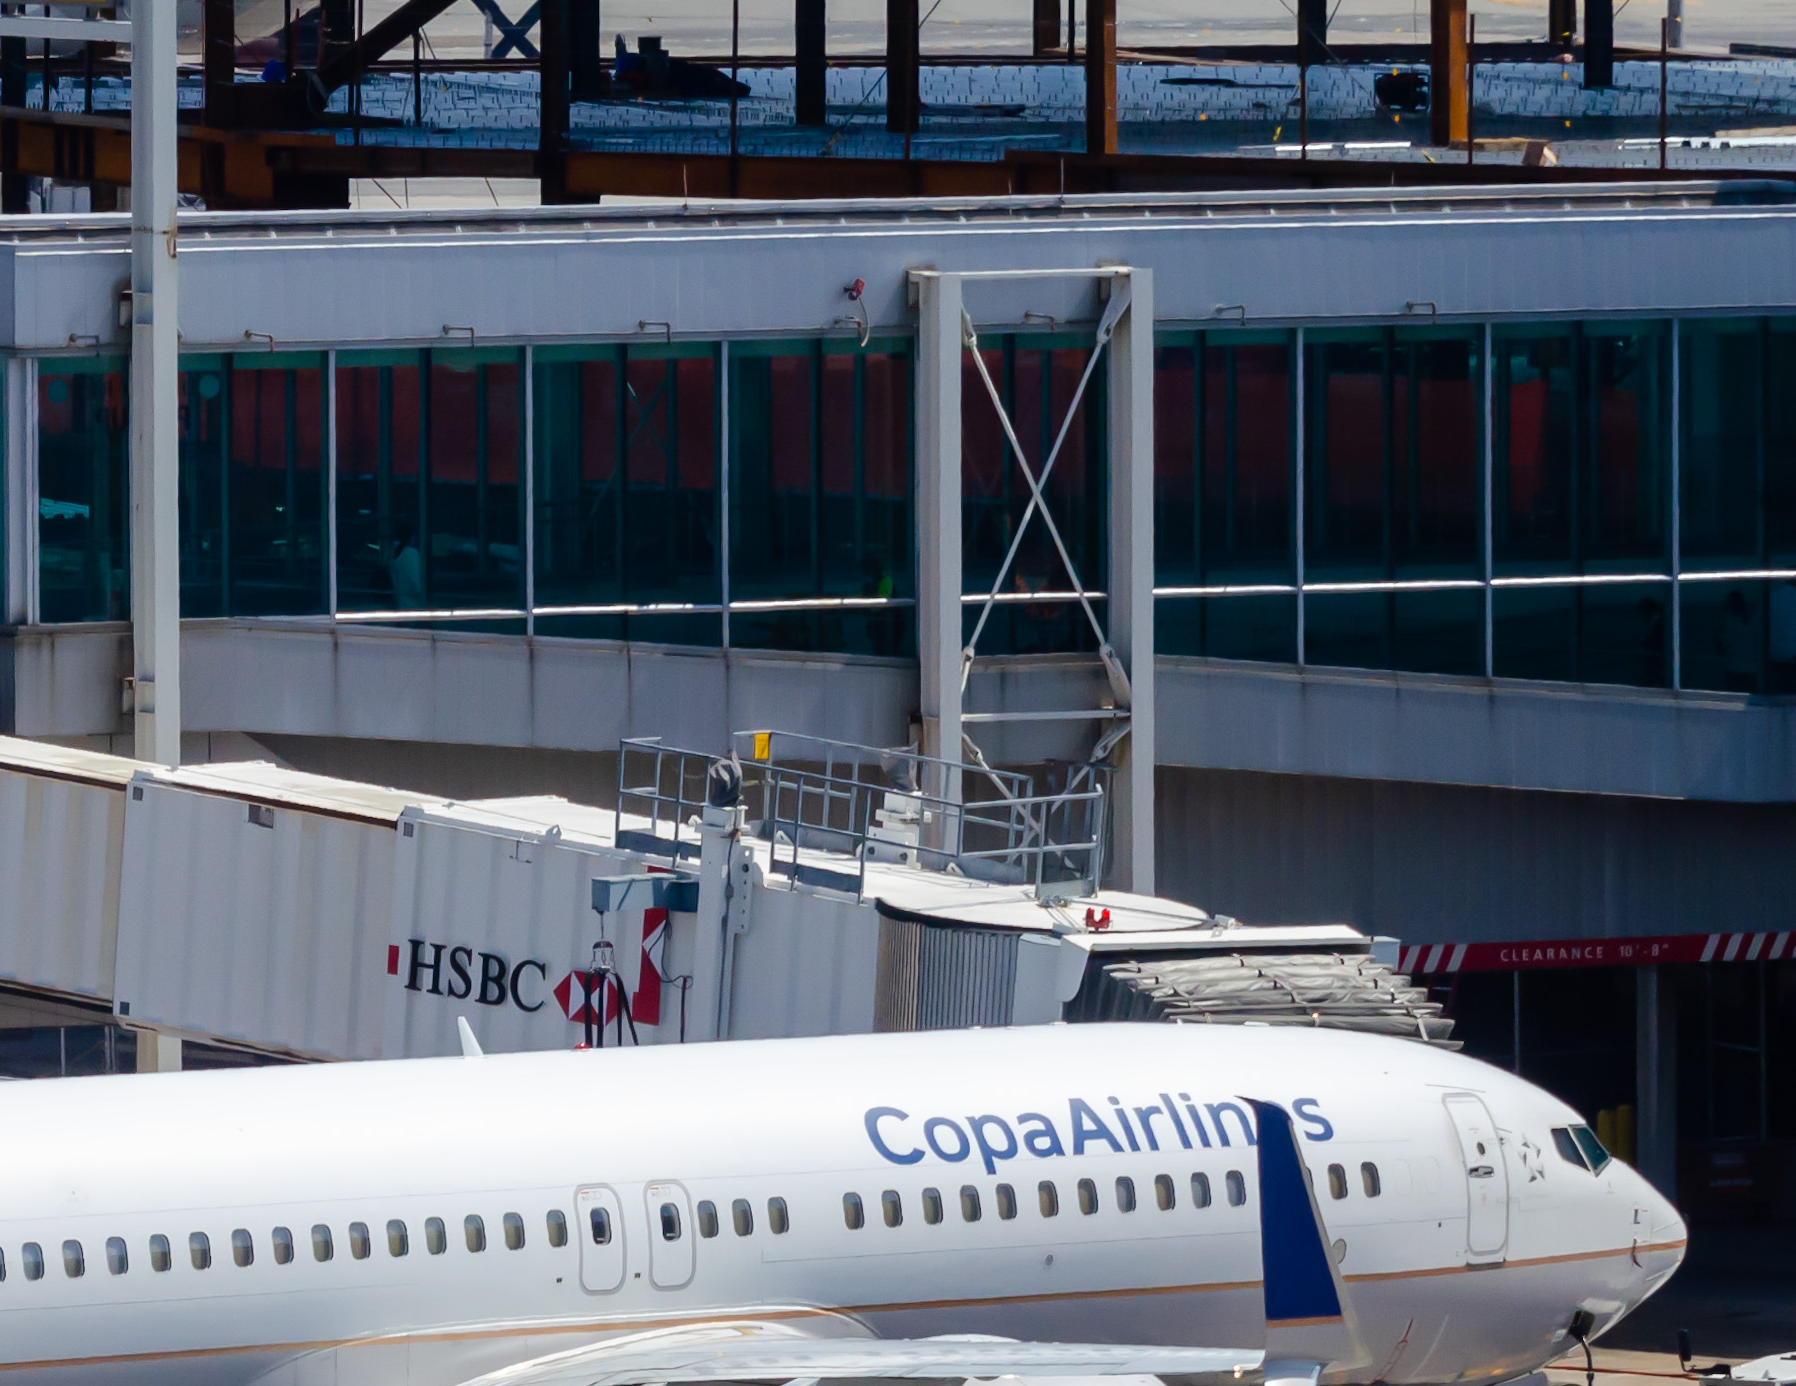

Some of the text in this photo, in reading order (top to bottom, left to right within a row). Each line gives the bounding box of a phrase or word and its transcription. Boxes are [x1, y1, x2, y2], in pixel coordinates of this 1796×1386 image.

[404, 938, 547, 1013] HSBC
[1500, 946, 1604, 962] CLEARANCE
[863, 1092, 1335, 1176] CopaAirlins
